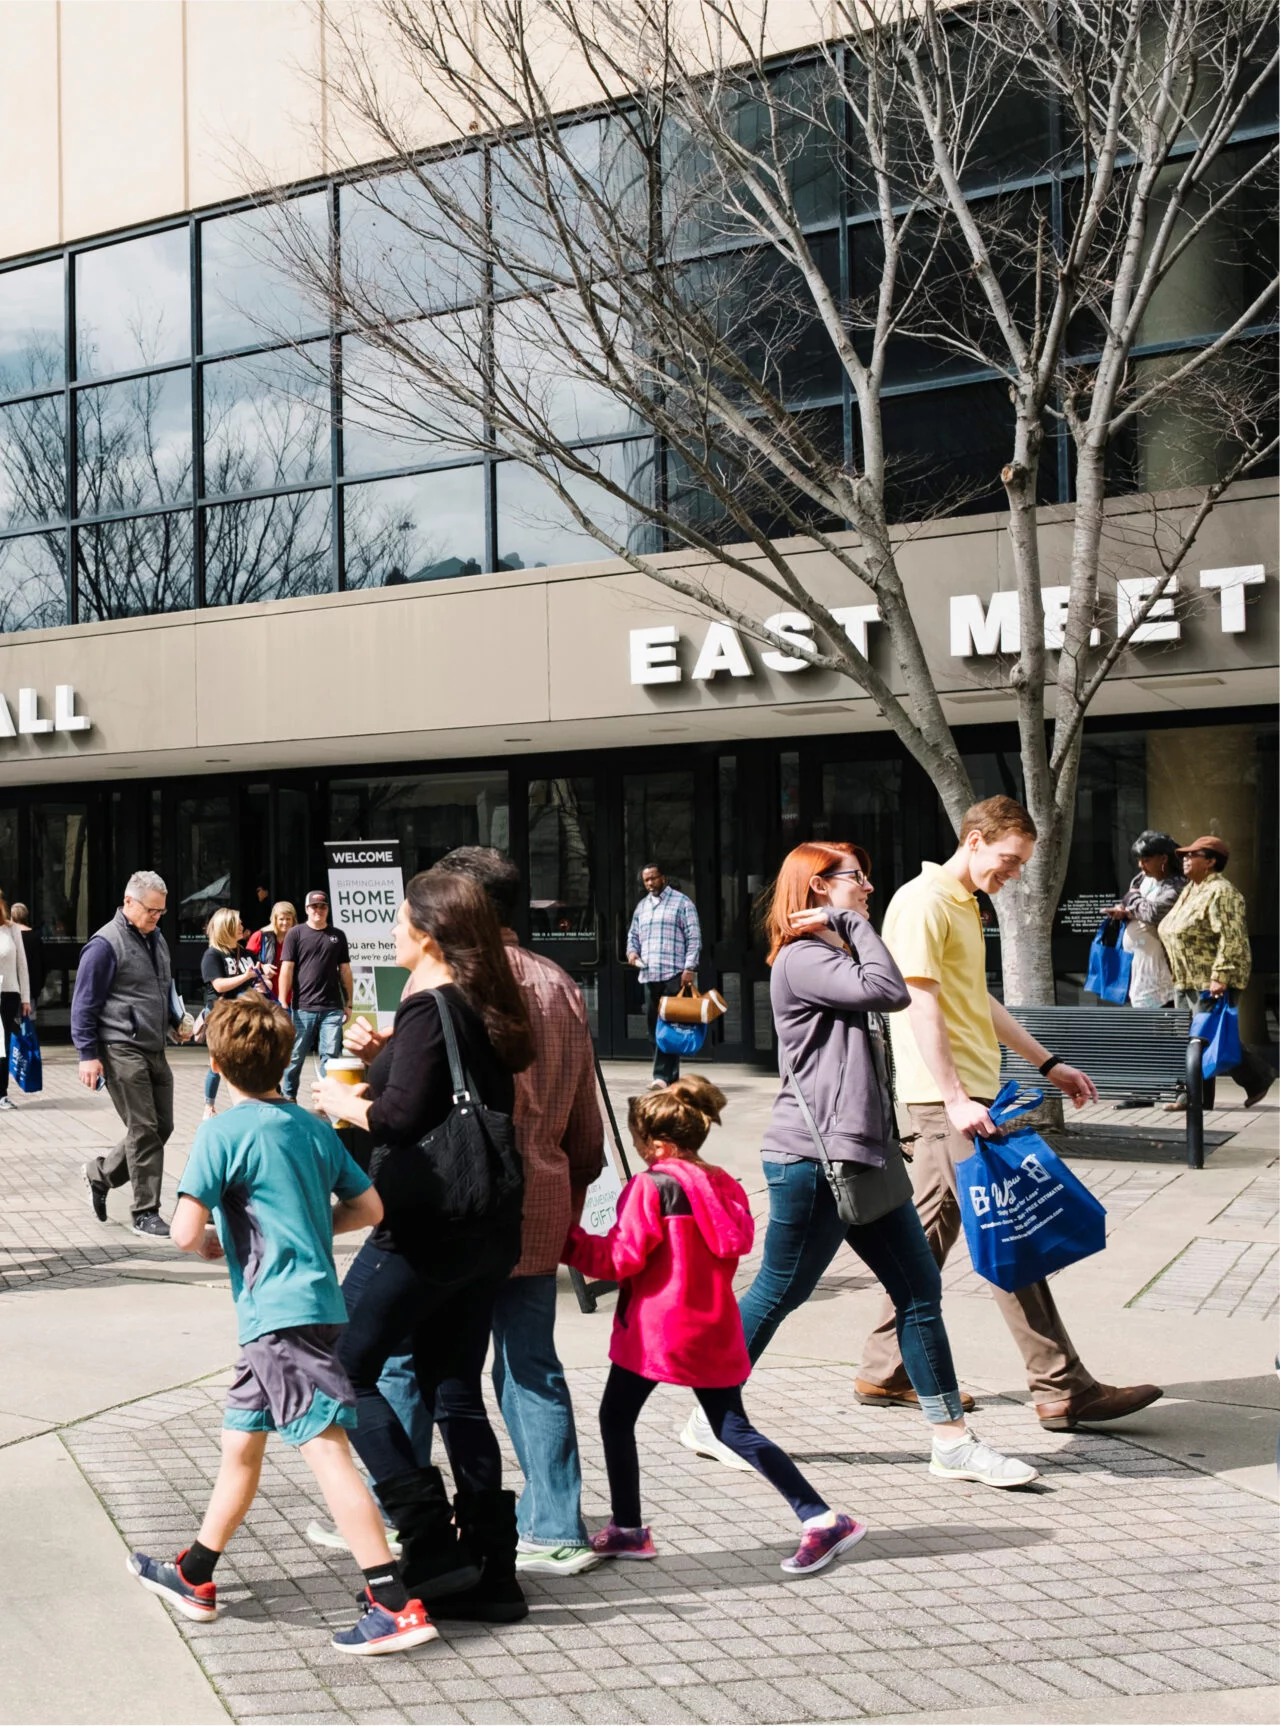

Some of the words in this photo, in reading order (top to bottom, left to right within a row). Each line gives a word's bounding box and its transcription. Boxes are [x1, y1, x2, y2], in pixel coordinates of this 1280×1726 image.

[629, 603, 884, 685] EAST
[332, 851, 394, 864] WELCOME
[337, 879, 395, 888] BIRMINGHAM
[338, 890, 396, 906] HOME
[340, 908, 396, 924] SHOW
[348, 942, 358, 950] ou
[360, 942, 376, 950] are
[378, 940, 397, 950] her
[350, 953, 360, 961] nd
[361, 953, 381, 961] we're
